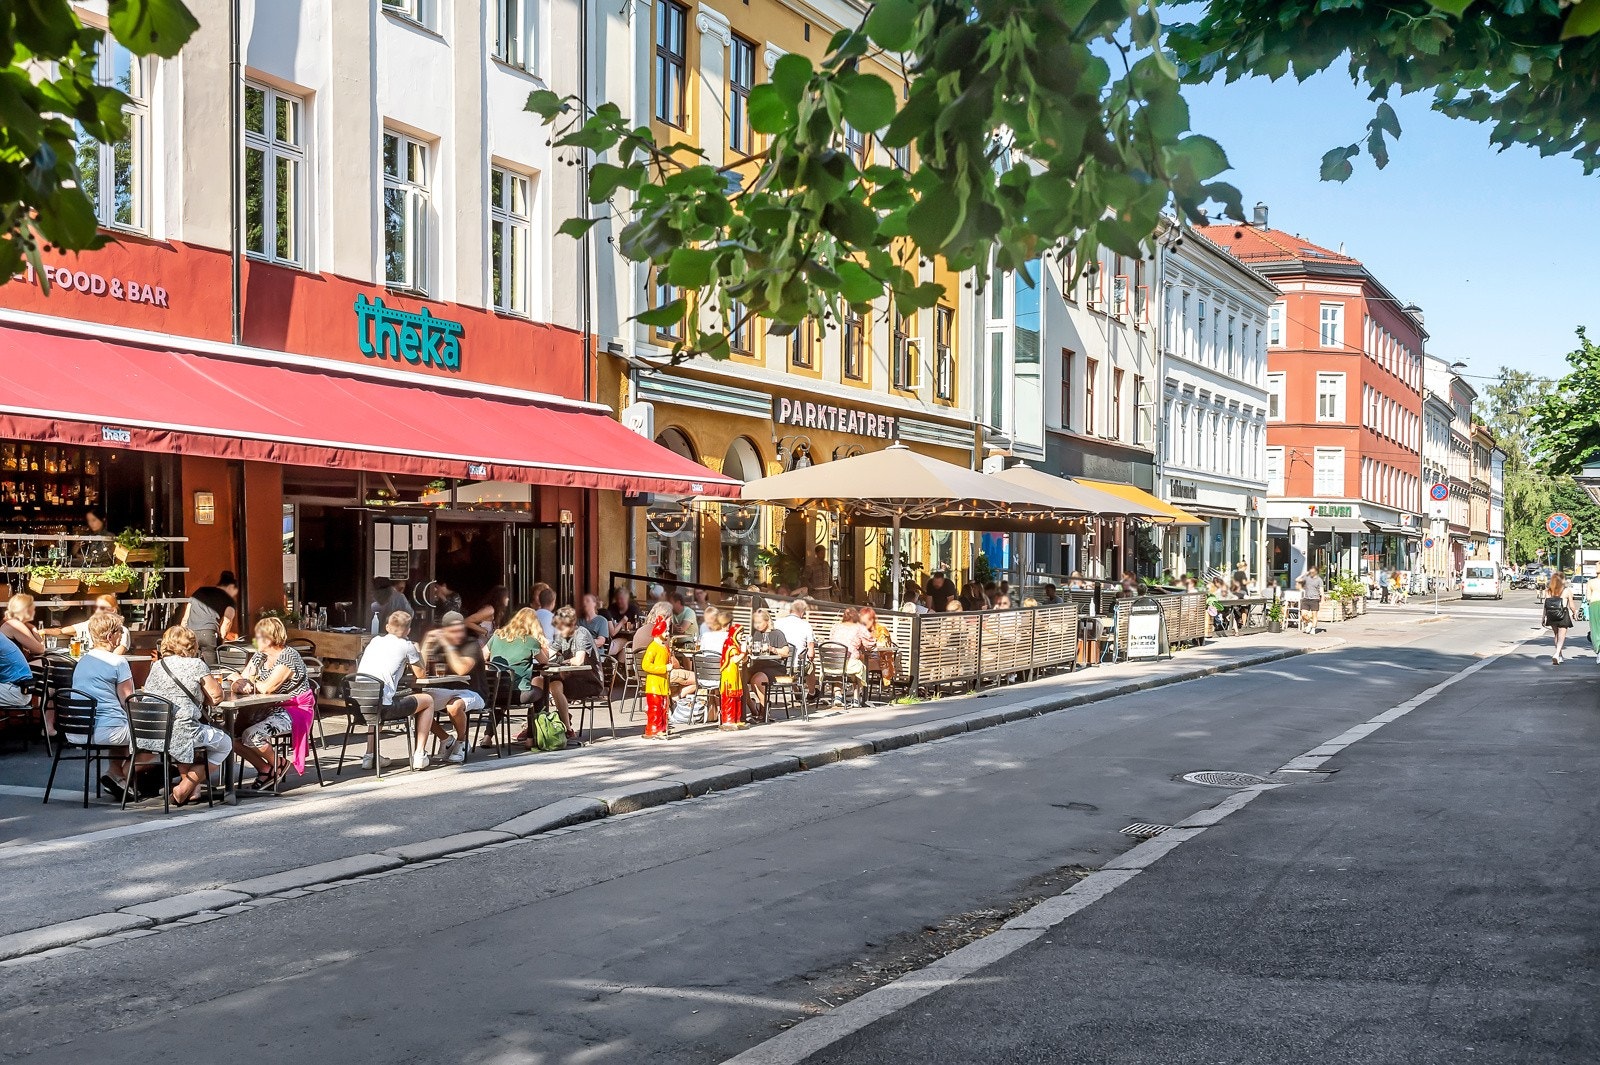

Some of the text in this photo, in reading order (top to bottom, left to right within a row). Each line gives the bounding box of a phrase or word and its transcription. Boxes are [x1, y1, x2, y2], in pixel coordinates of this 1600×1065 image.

[43, 264, 106, 294] FOOD
[109, 278, 124, 299] &
[127, 281, 168, 307] BAR
[354, 293, 463, 369] theka
[102, 426, 131, 443] theka
[778, 397, 895, 440] PARKTEATRET
